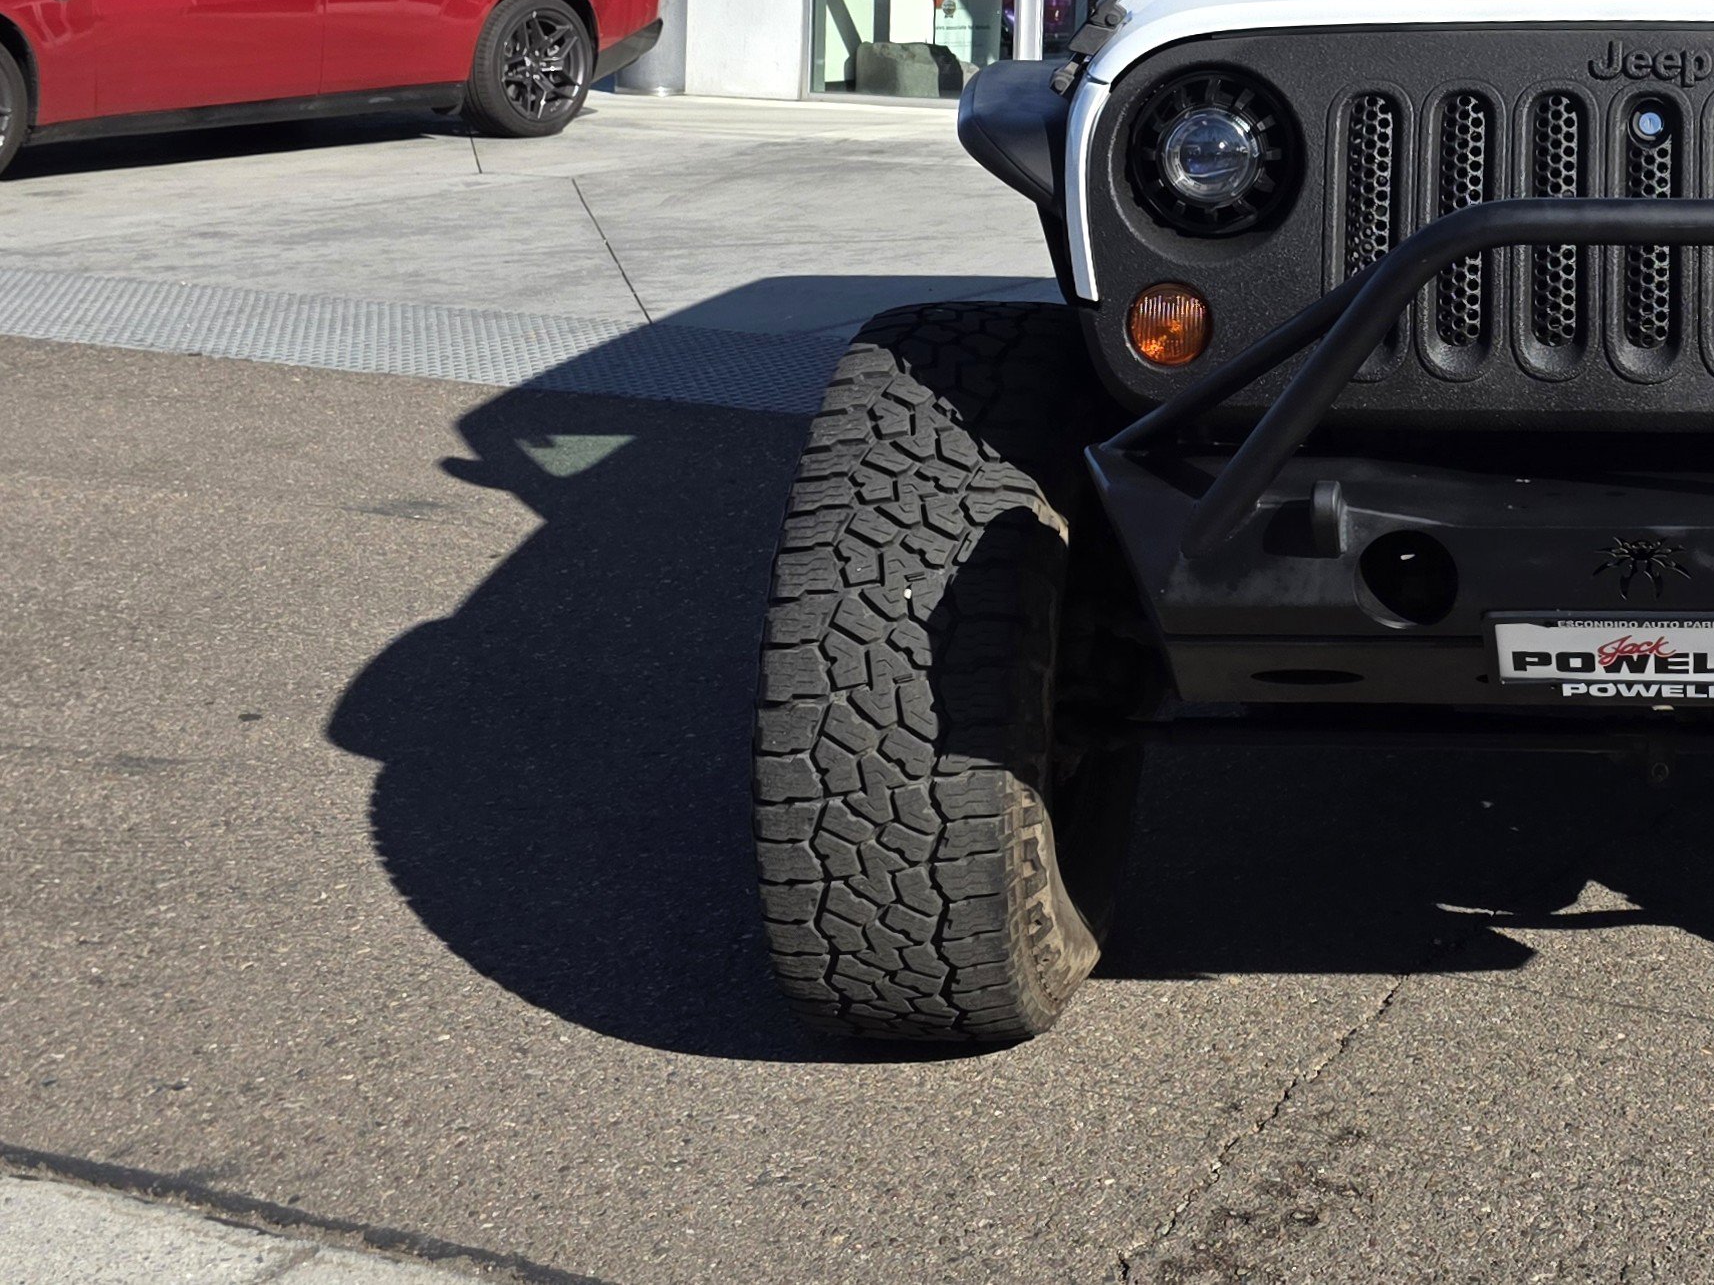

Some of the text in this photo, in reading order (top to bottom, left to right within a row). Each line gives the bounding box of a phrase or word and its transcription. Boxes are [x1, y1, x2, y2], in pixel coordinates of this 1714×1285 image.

[1587, 40, 1713, 87] Jeep
[1557, 620, 1639, 629] ESCONDIDO
[1641, 621, 1680, 629] AUTO
[1597, 634, 1676, 667] Jack
